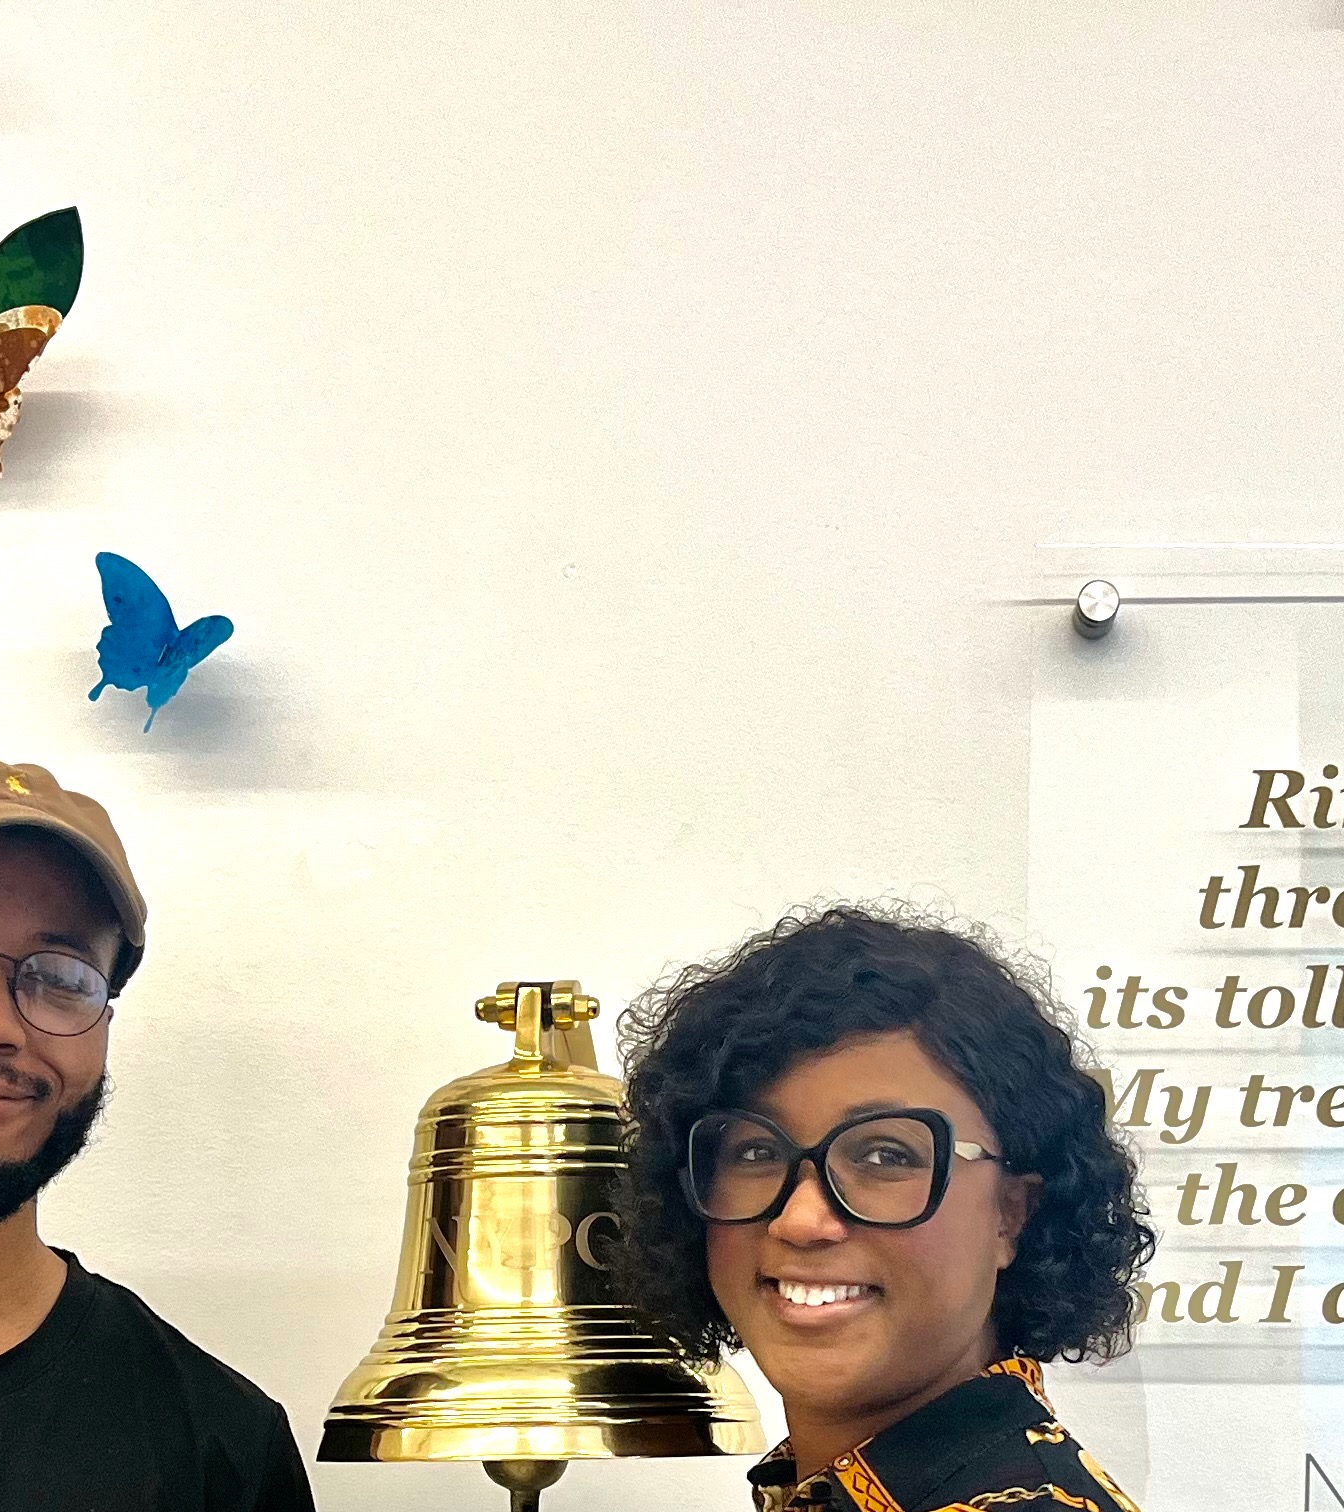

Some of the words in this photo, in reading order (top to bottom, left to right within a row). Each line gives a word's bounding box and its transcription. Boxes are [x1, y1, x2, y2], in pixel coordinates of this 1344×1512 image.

[1084, 966, 1188, 1029] its
[1088, 1068, 1212, 1145] My
[1176, 1162, 1308, 1227] the
[1132, 1260, 1243, 1325] nd
[1258, 1265, 1306, 1323] I
